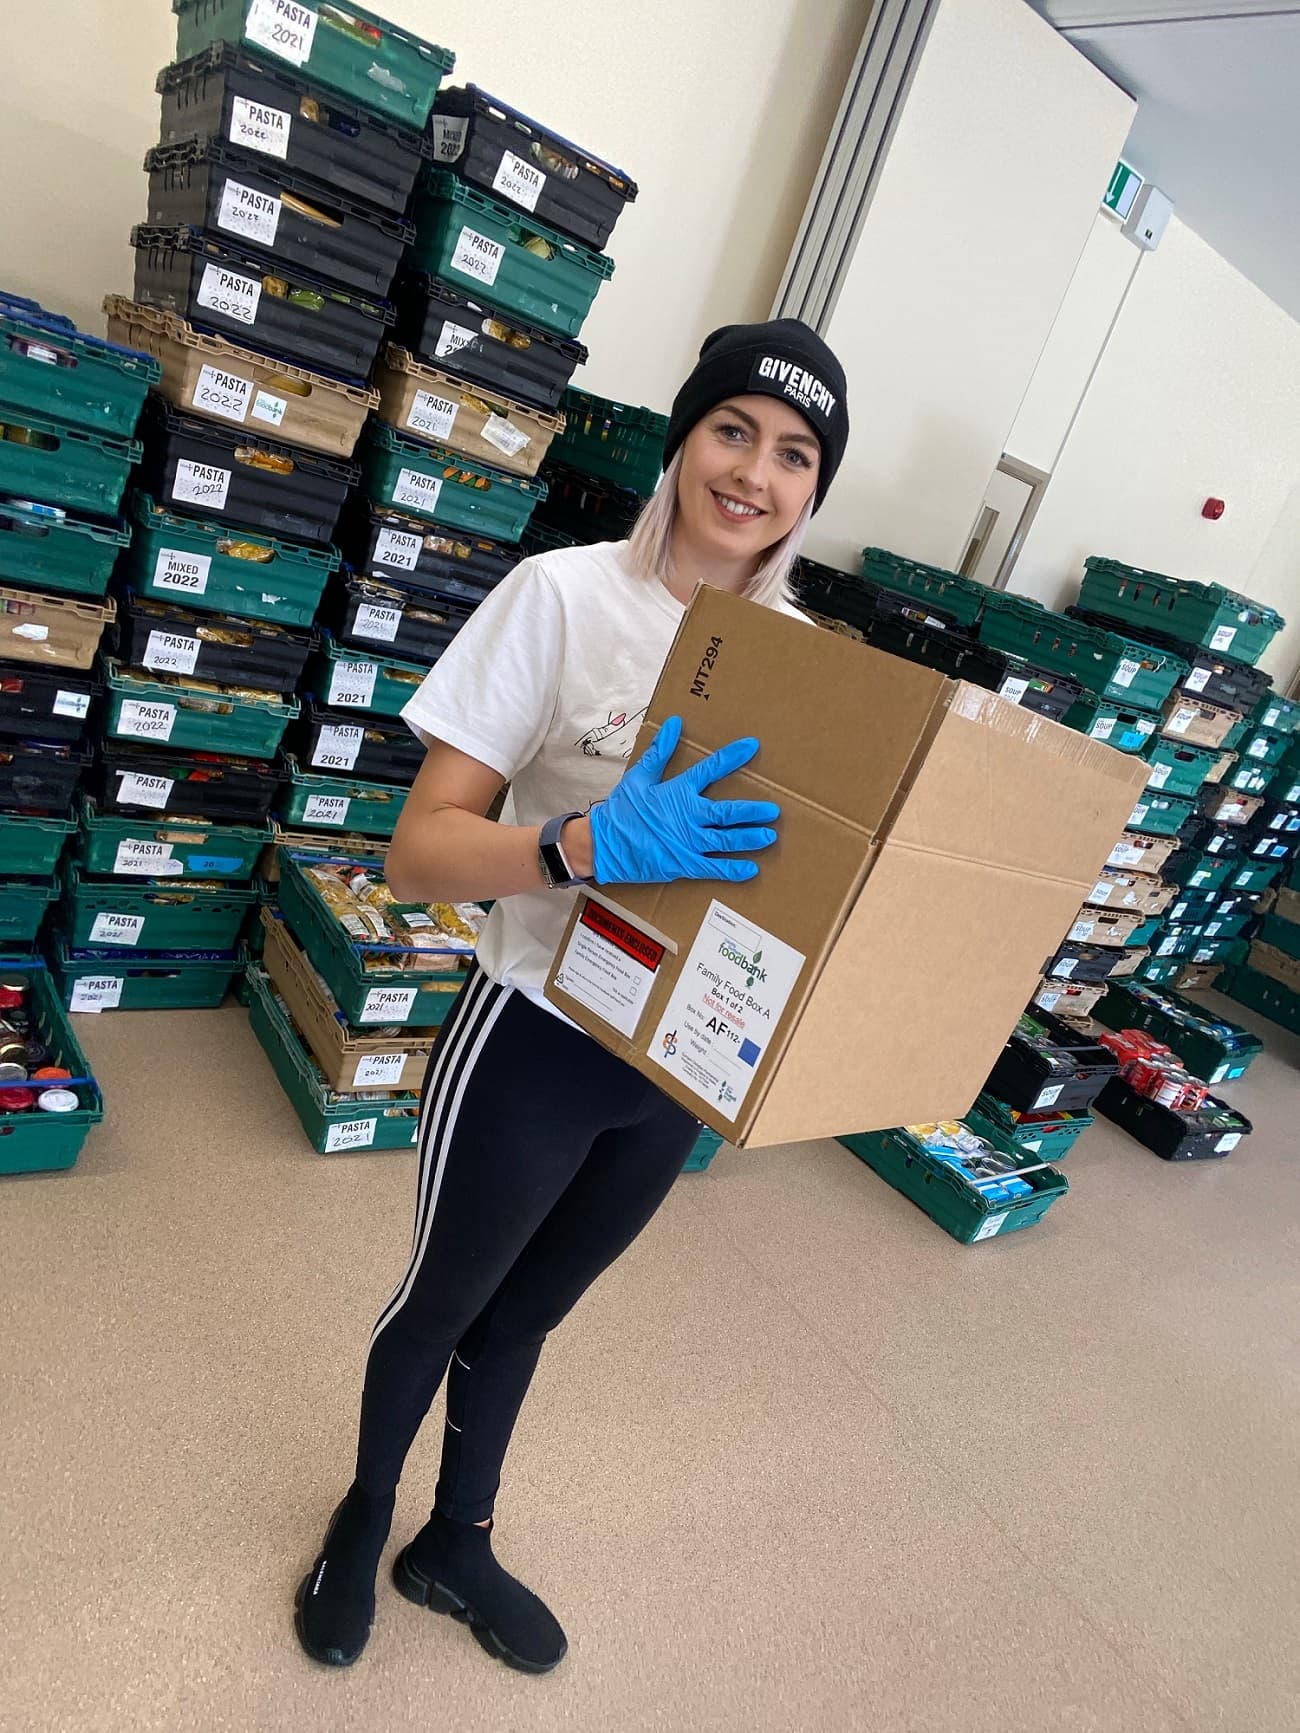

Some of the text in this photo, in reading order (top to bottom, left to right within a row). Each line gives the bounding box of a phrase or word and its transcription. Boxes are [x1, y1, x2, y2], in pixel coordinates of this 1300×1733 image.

[275, 0, 311, 29] PASTA
[272, 24, 303, 51] 2021
[249, 106, 283, 130] PASTA
[513, 162, 540, 187] PASTA
[240, 190, 275, 215] PASTA
[471, 236, 499, 259] PASTA
[219, 273, 254, 297] PASTA
[210, 296, 252, 320] 2022
[215, 373, 247, 395] PASTA
[758, 356, 836, 418] GIVENCHY
[200, 388, 243, 412] 2022
[784, 384, 812, 408] PARIS
[426, 396, 453, 415] PASTA
[193, 465, 224, 483] PASTA
[193, 484, 223, 495] 2022
[410, 475, 436, 492] PASTA
[401, 493, 425, 507] 2021
[391, 533, 416, 549] PASTA
[383, 551, 412, 567] 2021
[168, 561, 198, 575] MIXED
[163, 572, 199, 588] 2022
[369, 608, 395, 621] PASTA
[164, 636, 194, 651] PASTA
[154, 656, 177, 666] 2022
[347, 663, 373, 674] PASTA
[690, 635, 723, 697] MT294
[1121, 663, 1137, 673] SOUP
[337, 693, 366, 703] 2021
[1005, 687, 1022, 695] SOUP
[138, 706, 169, 721] PASTA
[134, 722, 167, 731] 2022
[333, 727, 359, 738] PASTA
[1096, 722, 1112, 730] SOUP
[320, 755, 349, 766] 2021
[136, 776, 166, 789] PASTA
[318, 797, 344, 808] PASTA
[307, 809, 337, 819] 2021
[133, 844, 162, 855] PASTA
[108, 916, 138, 928] PASTA
[718, 942, 768, 983] foodbank
[88, 980, 118, 990] PASTA
[696, 963, 770, 1020] Family Food Box A
[379, 993, 408, 1002] PASTA
[711, 988, 743, 1014] Box 1 of 2
[372, 1055, 402, 1065] PASTA
[341, 1121, 370, 1133] PASTA
[334, 1132, 370, 1147] 2021
